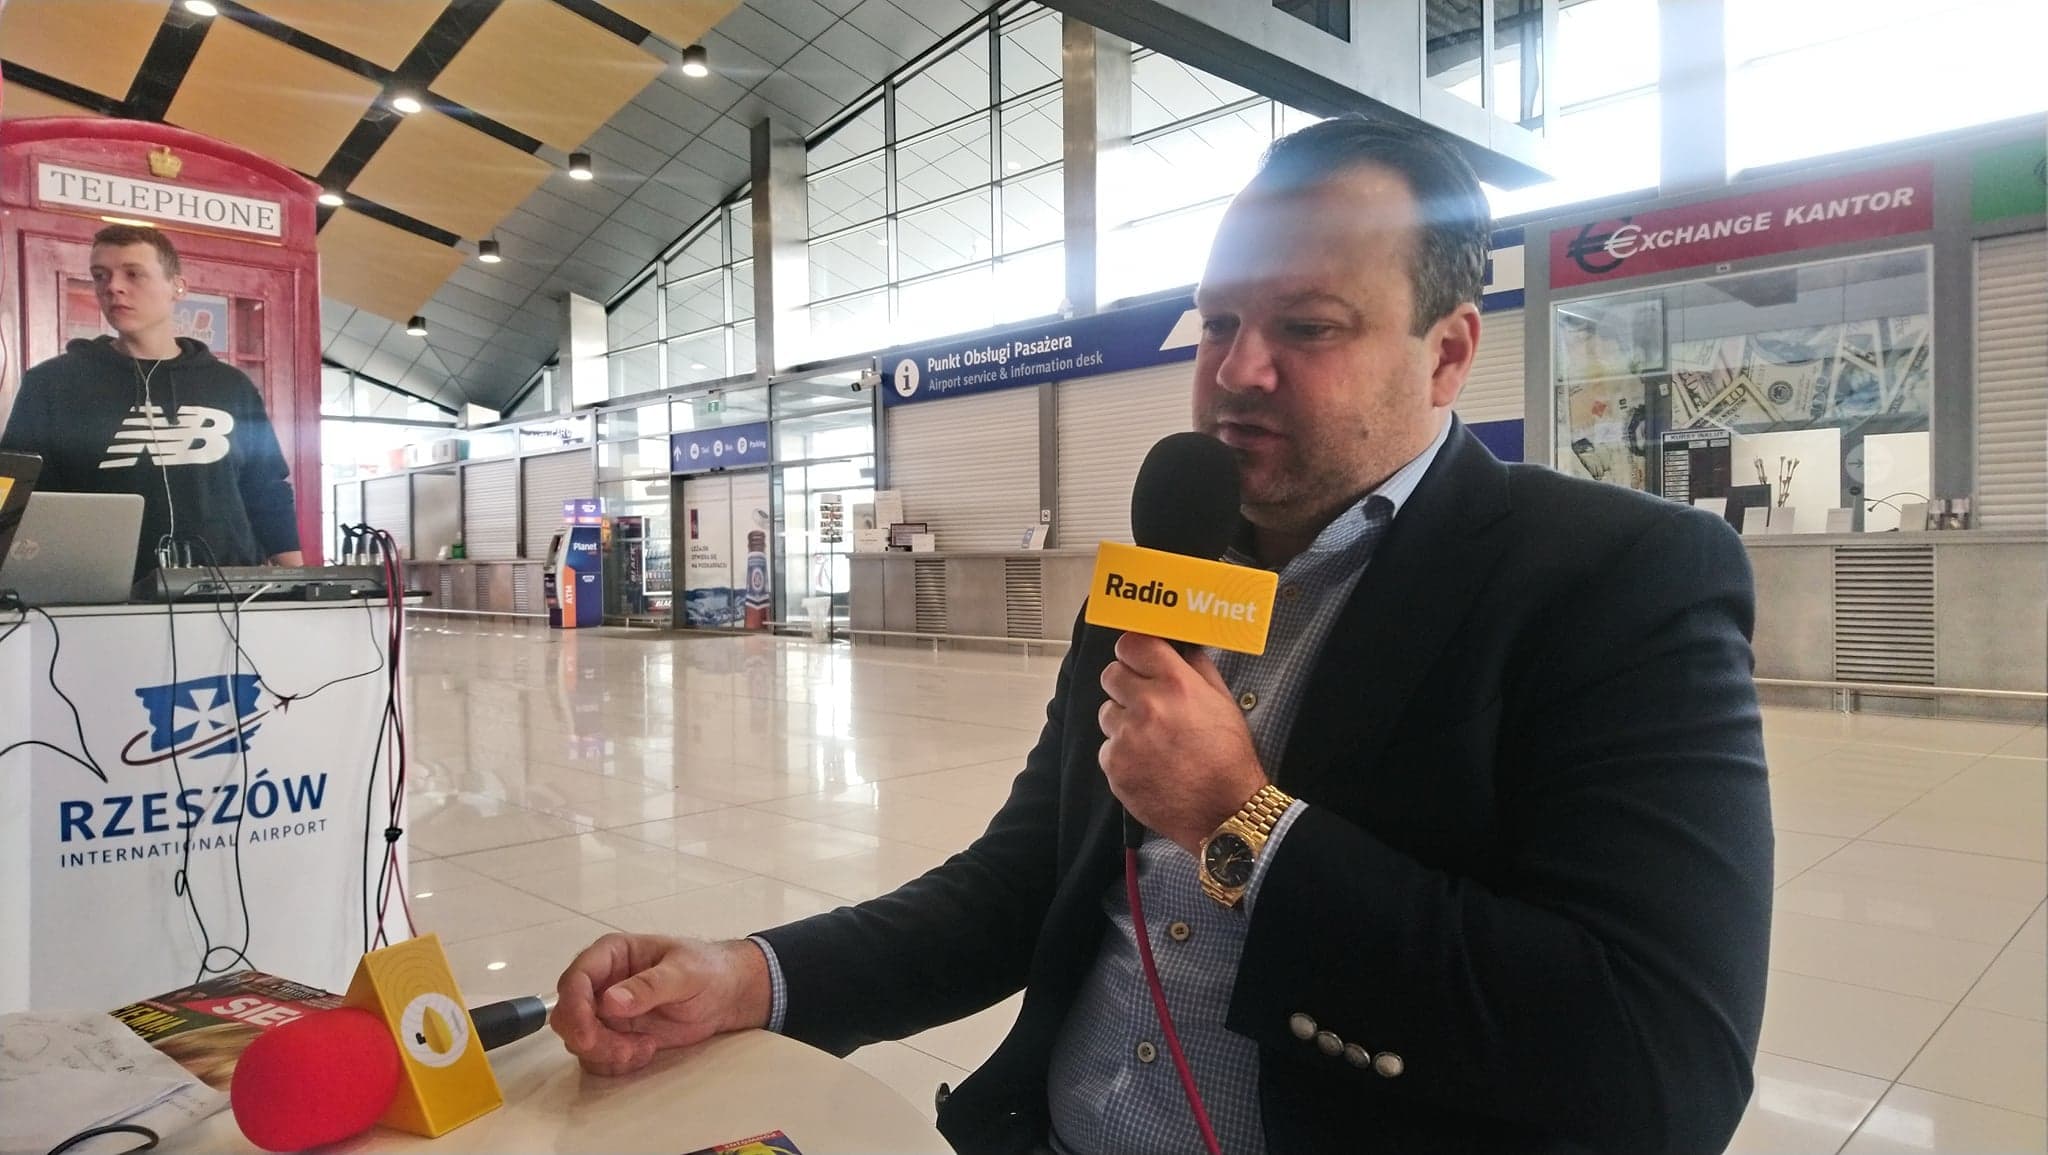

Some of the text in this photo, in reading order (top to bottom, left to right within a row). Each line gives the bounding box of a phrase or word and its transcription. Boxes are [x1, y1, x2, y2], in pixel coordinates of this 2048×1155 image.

[50, 169, 274, 231] TELEPHONE
[1784, 187, 1915, 227] KANTOR
[927, 334, 1073, 373] Punkt Obsługi Pasażera
[928, 350, 1104, 392] Airport service & information desk
[97, 405, 235, 469] NB
[573, 542, 597, 551] Planet
[565, 585, 573, 604] ATM
[1105, 573, 1257, 624] Radio Wnet
[60, 768, 328, 843] RZESZÓW
[60, 818, 327, 868] INTERNATIONAL AIRPORT
